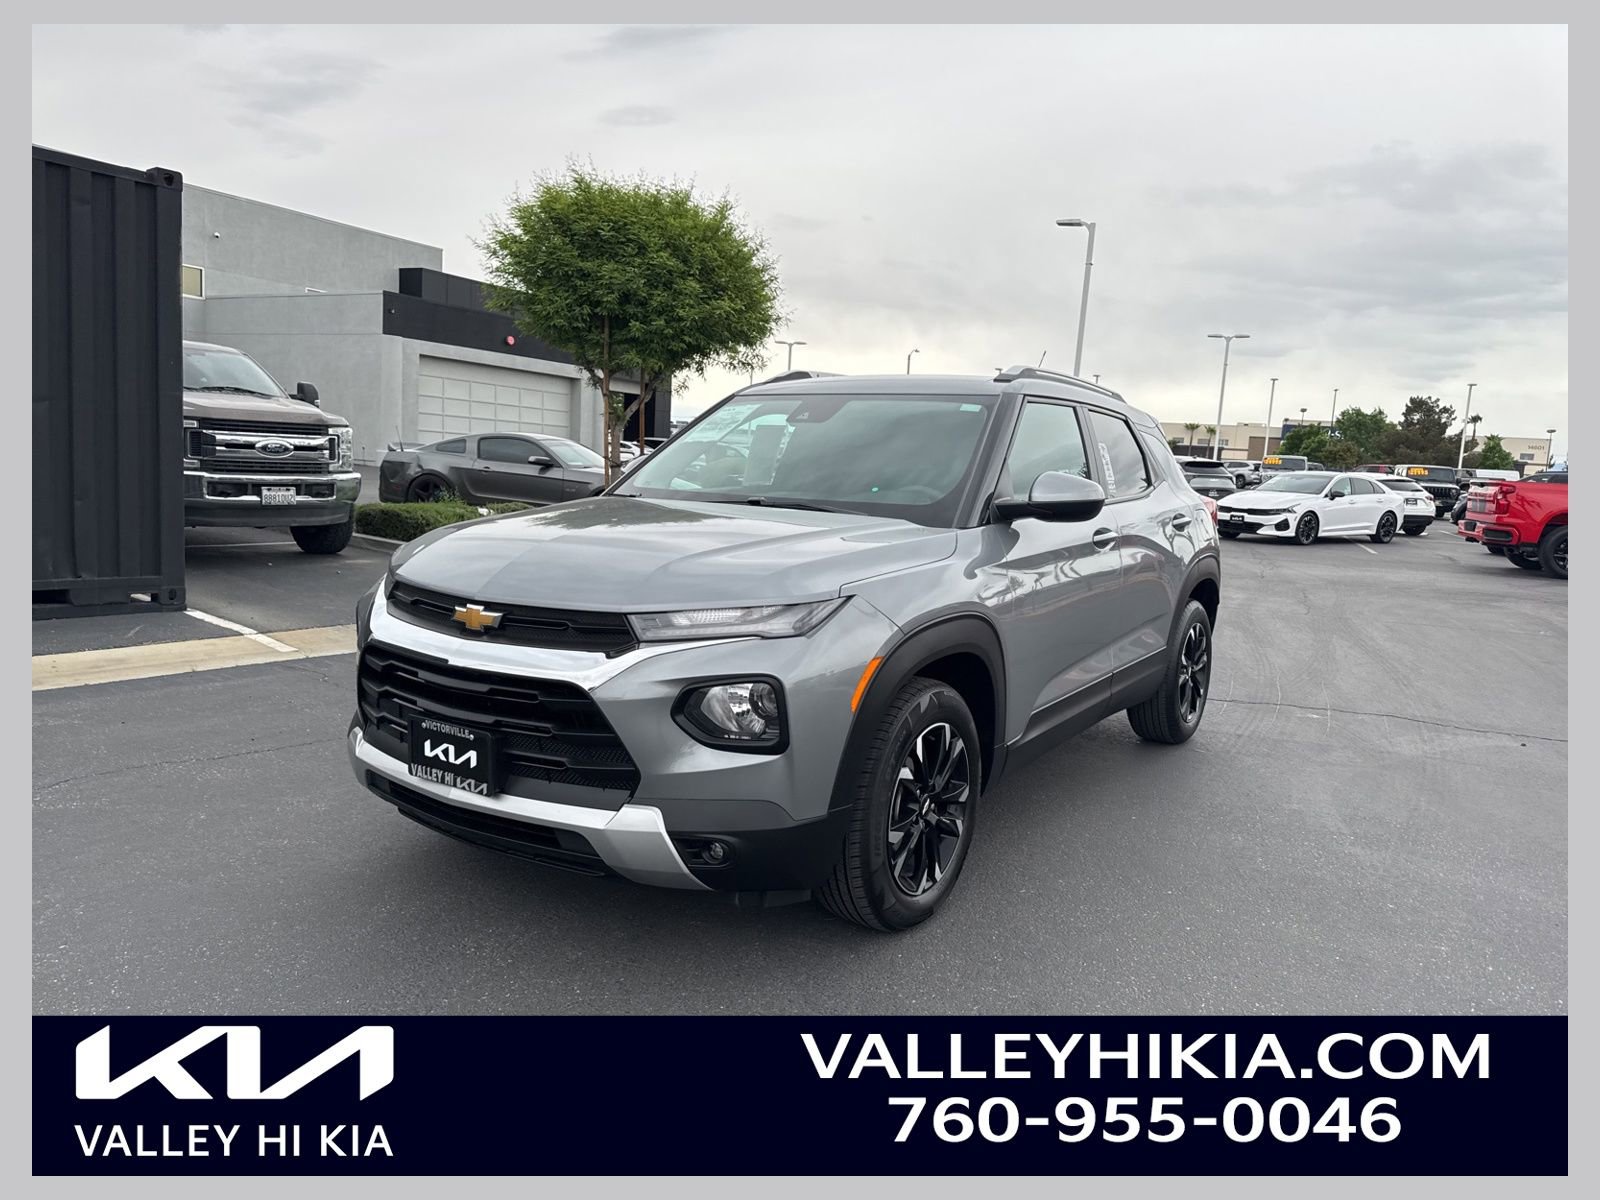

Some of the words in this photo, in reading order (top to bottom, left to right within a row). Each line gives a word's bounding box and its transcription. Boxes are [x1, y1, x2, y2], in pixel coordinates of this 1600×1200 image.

[425, 720, 470, 739] VICTORVILLE
[424, 739, 477, 769] KIA
[411, 763, 443, 783] VALLEY
[444, 771, 455, 786] HI
[456, 776, 488, 795] KIA
